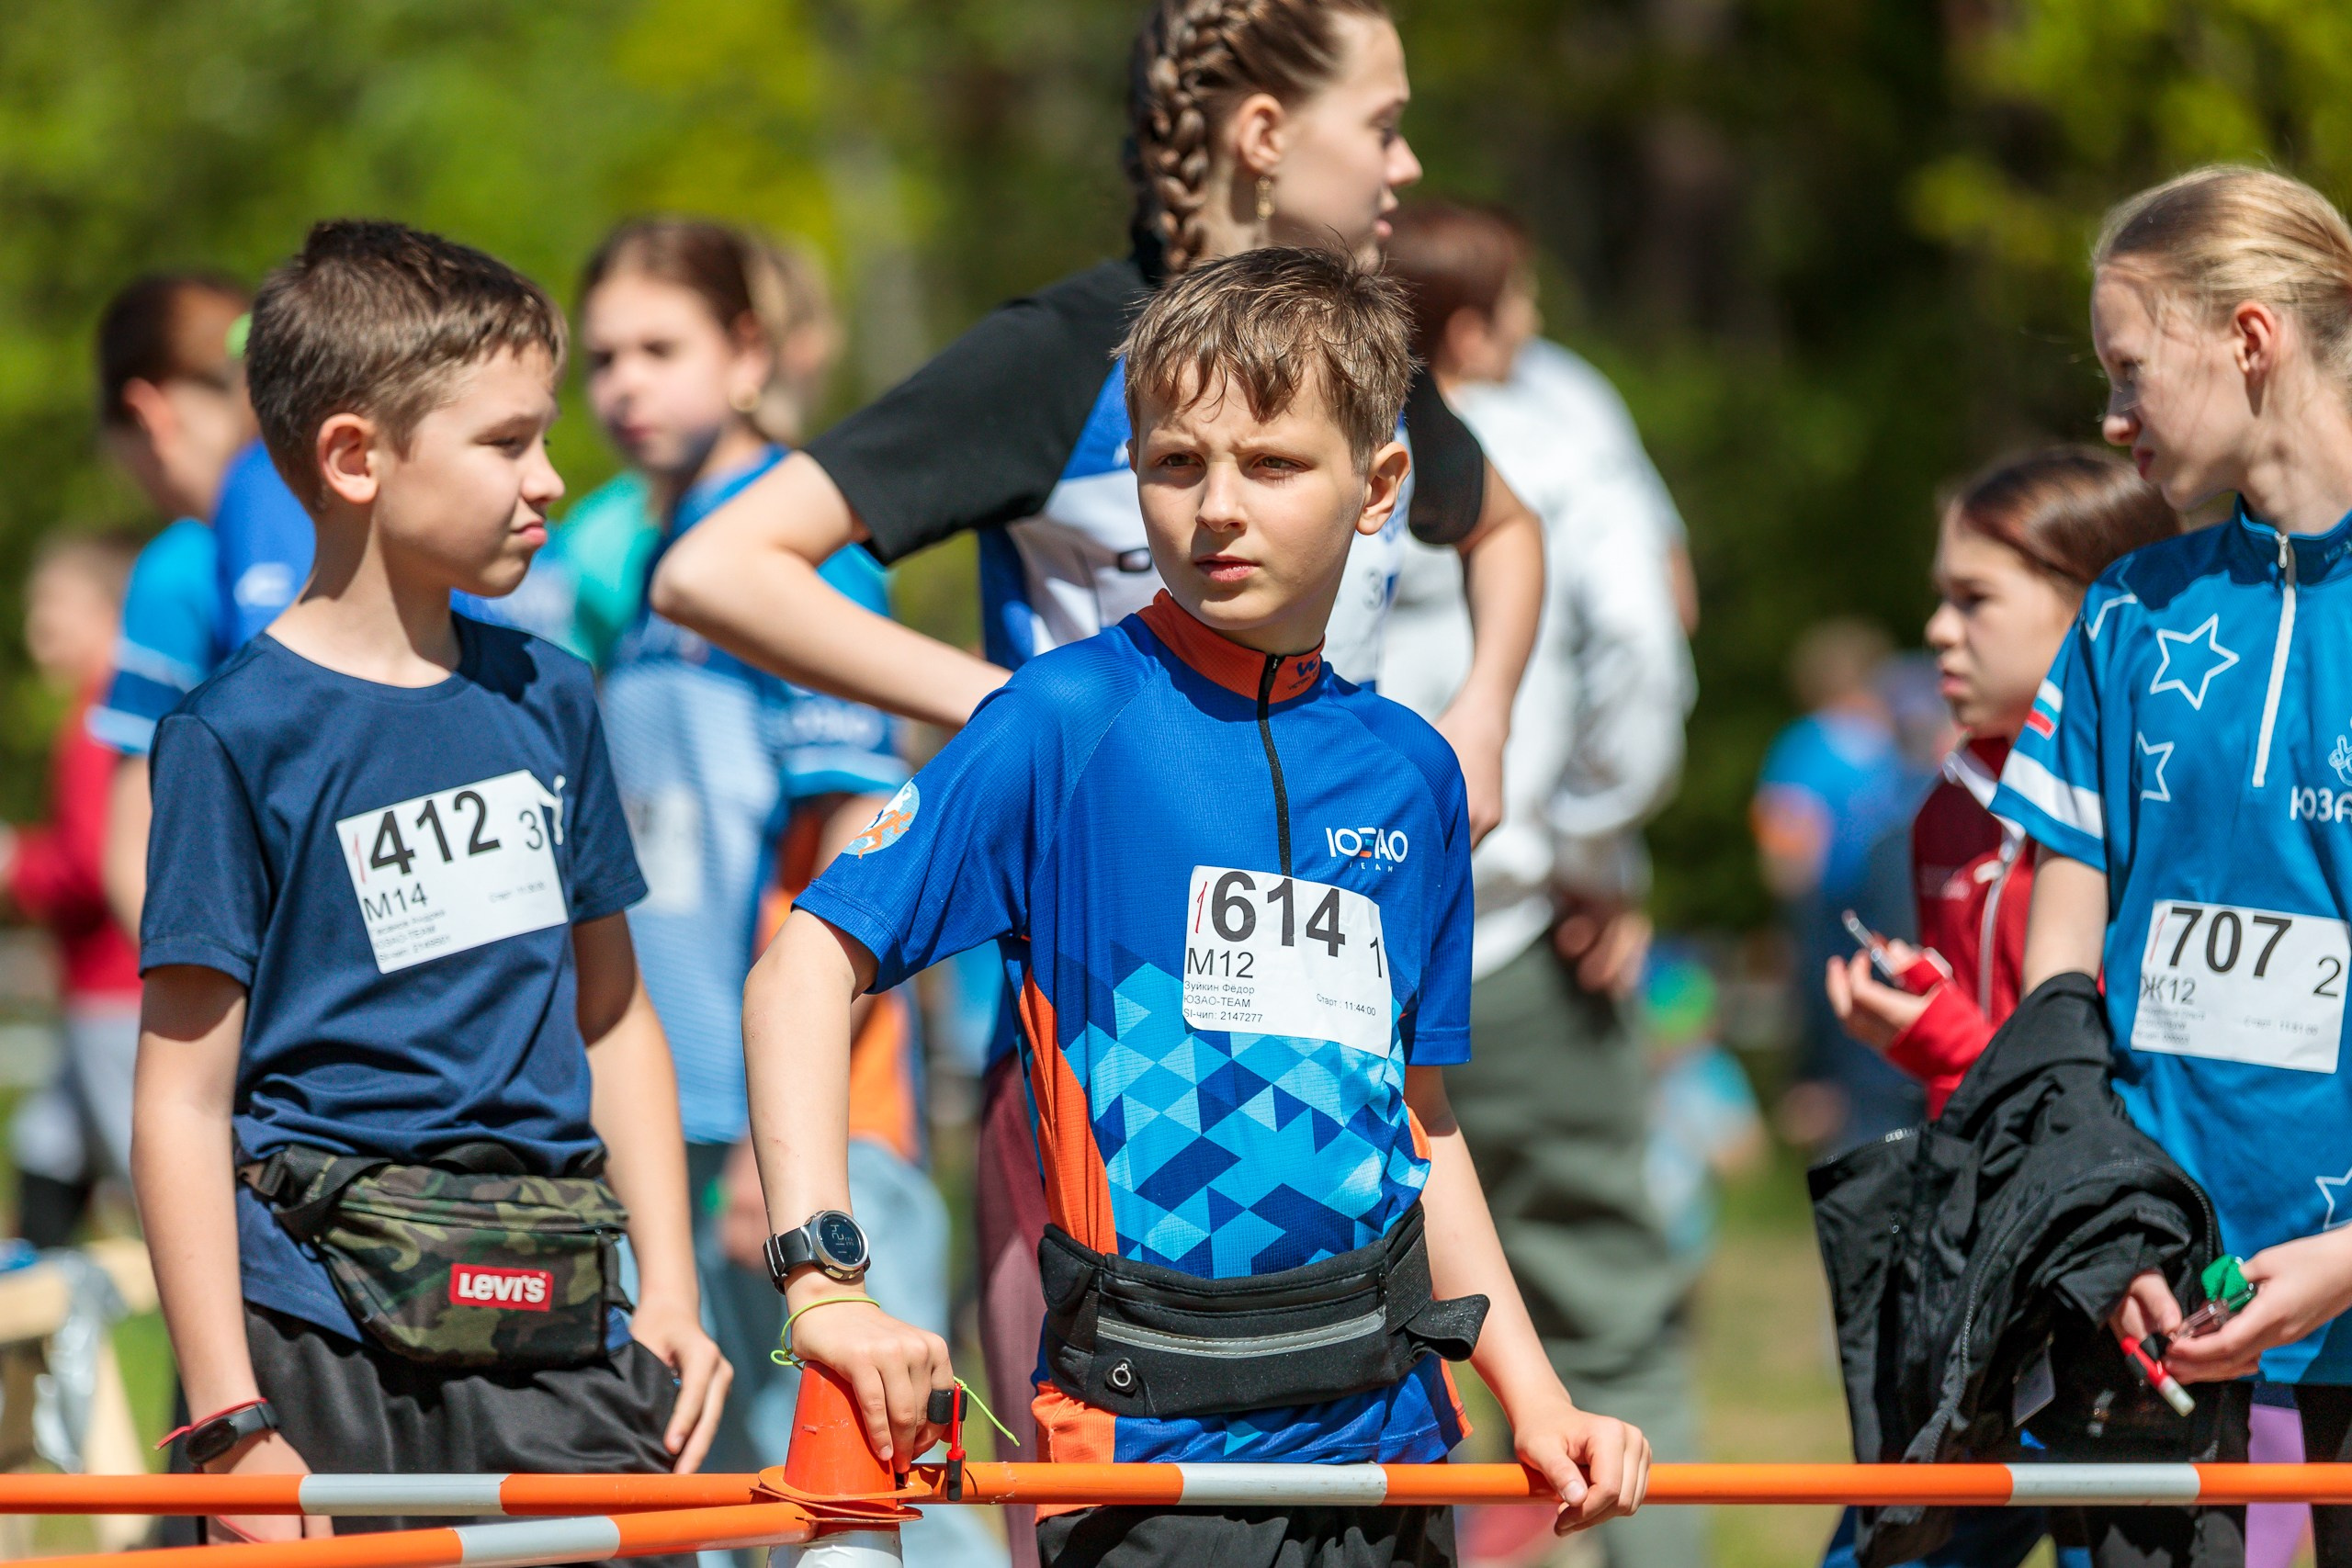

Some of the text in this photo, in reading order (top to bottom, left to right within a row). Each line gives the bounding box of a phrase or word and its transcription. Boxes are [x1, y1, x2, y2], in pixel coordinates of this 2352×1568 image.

[370, 790, 501, 875] 412
[519, 810, 544, 851] 3
[1212, 871, 1346, 957] 614
[1370, 937, 1382, 978] 1
[2169, 907, 2292, 978] 707
[1184, 981, 1255, 996] Зуйкин Фёдор
[2312, 956, 2342, 998] 2
[1220, 1011, 1262, 1022] 2147277
[1345, 1001, 1376, 1016] 11:44:00
